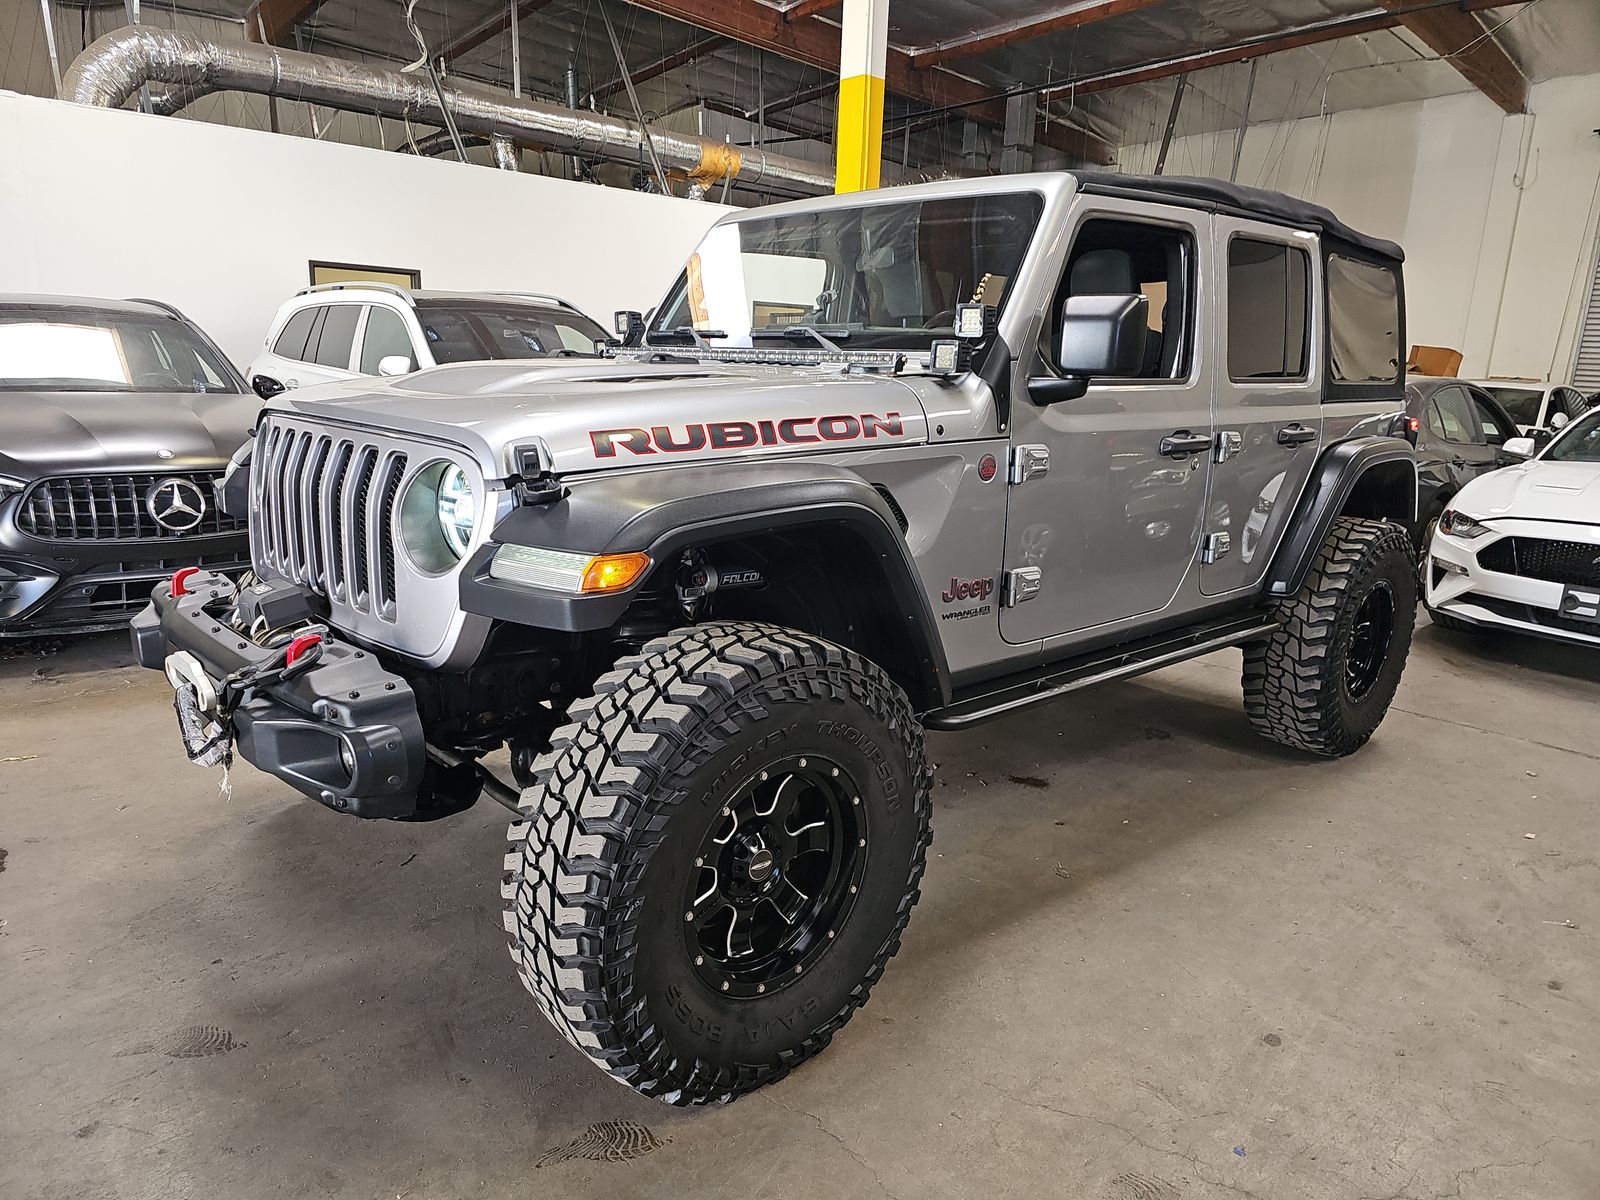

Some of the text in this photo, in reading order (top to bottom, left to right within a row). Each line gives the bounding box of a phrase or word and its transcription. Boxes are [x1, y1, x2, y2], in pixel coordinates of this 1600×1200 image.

[588, 412, 903, 458] RUBICON
[942, 577, 993, 603] Jeep
[942, 606, 991, 620] WRANGLER
[701, 719, 902, 811] MICKEY THOMPSON
